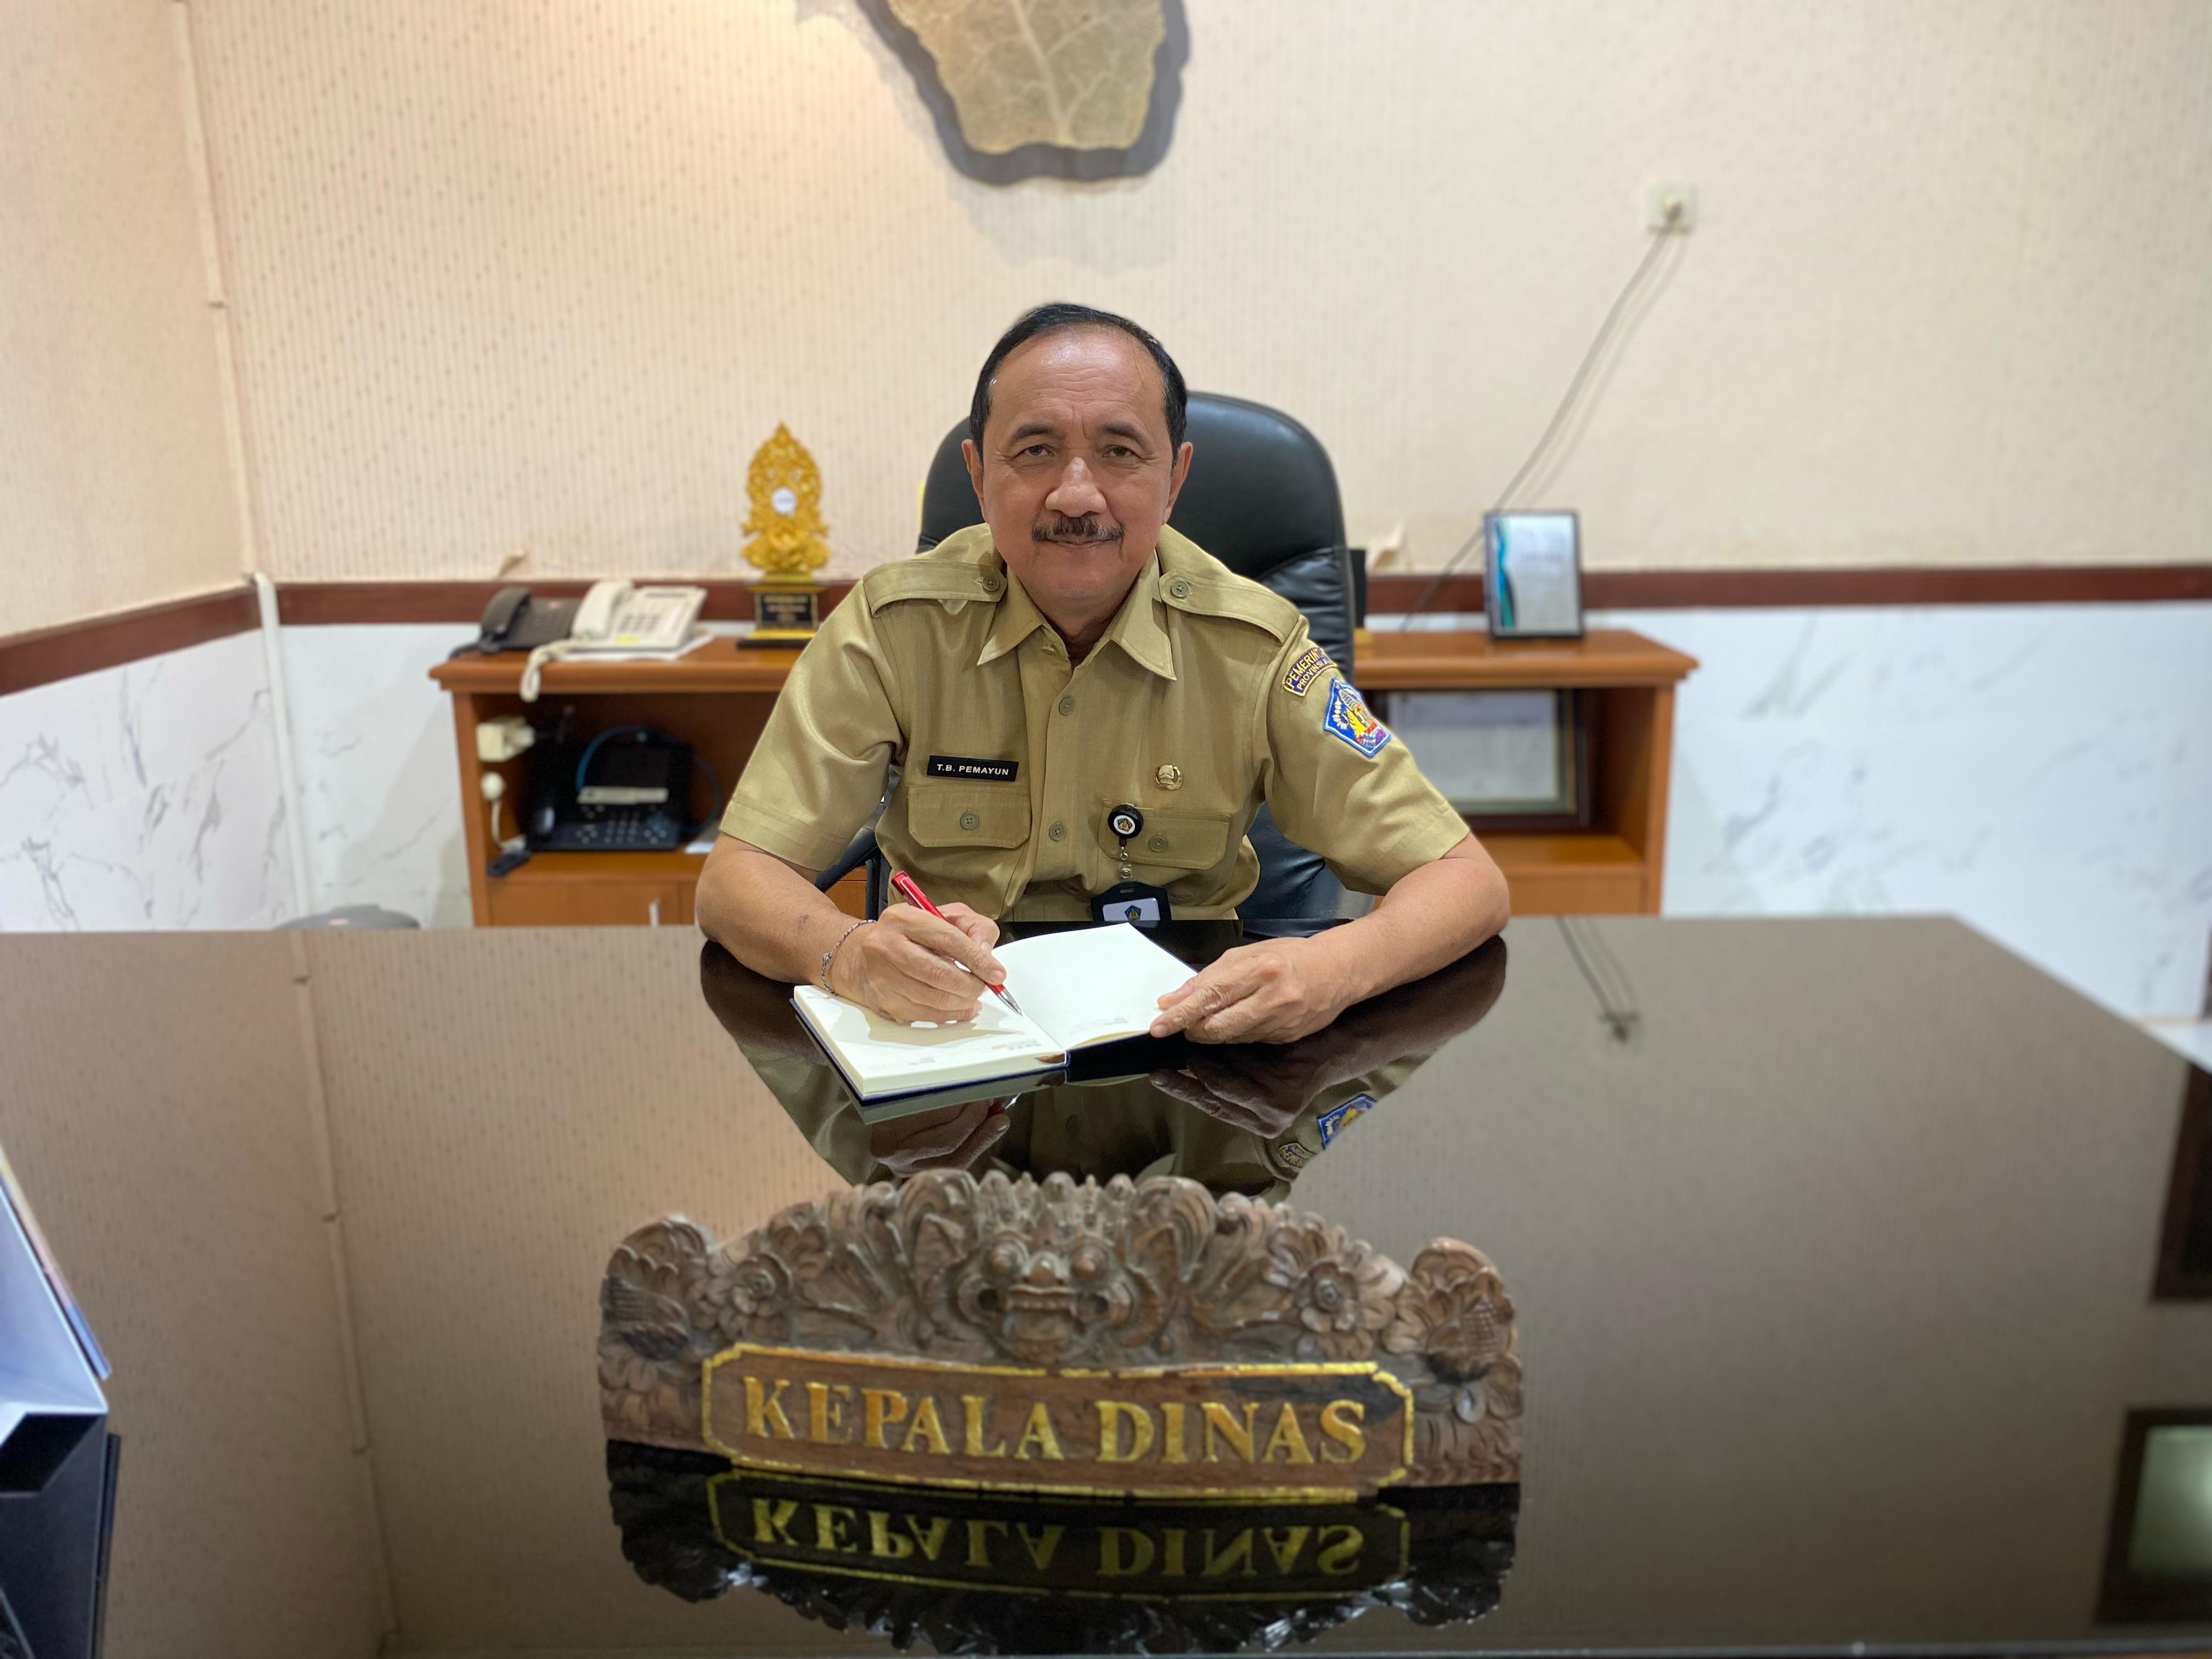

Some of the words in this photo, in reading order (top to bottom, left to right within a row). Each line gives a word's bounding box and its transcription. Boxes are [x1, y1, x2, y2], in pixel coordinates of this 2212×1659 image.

[1296, 660, 1324, 690] PROVINSI
[936, 764, 956, 772] T.B.
[958, 765, 1009, 775] PEMAYUN
[743, 1376, 1065, 1460] KEPALA
[1093, 1399, 1367, 1464] DINAS
